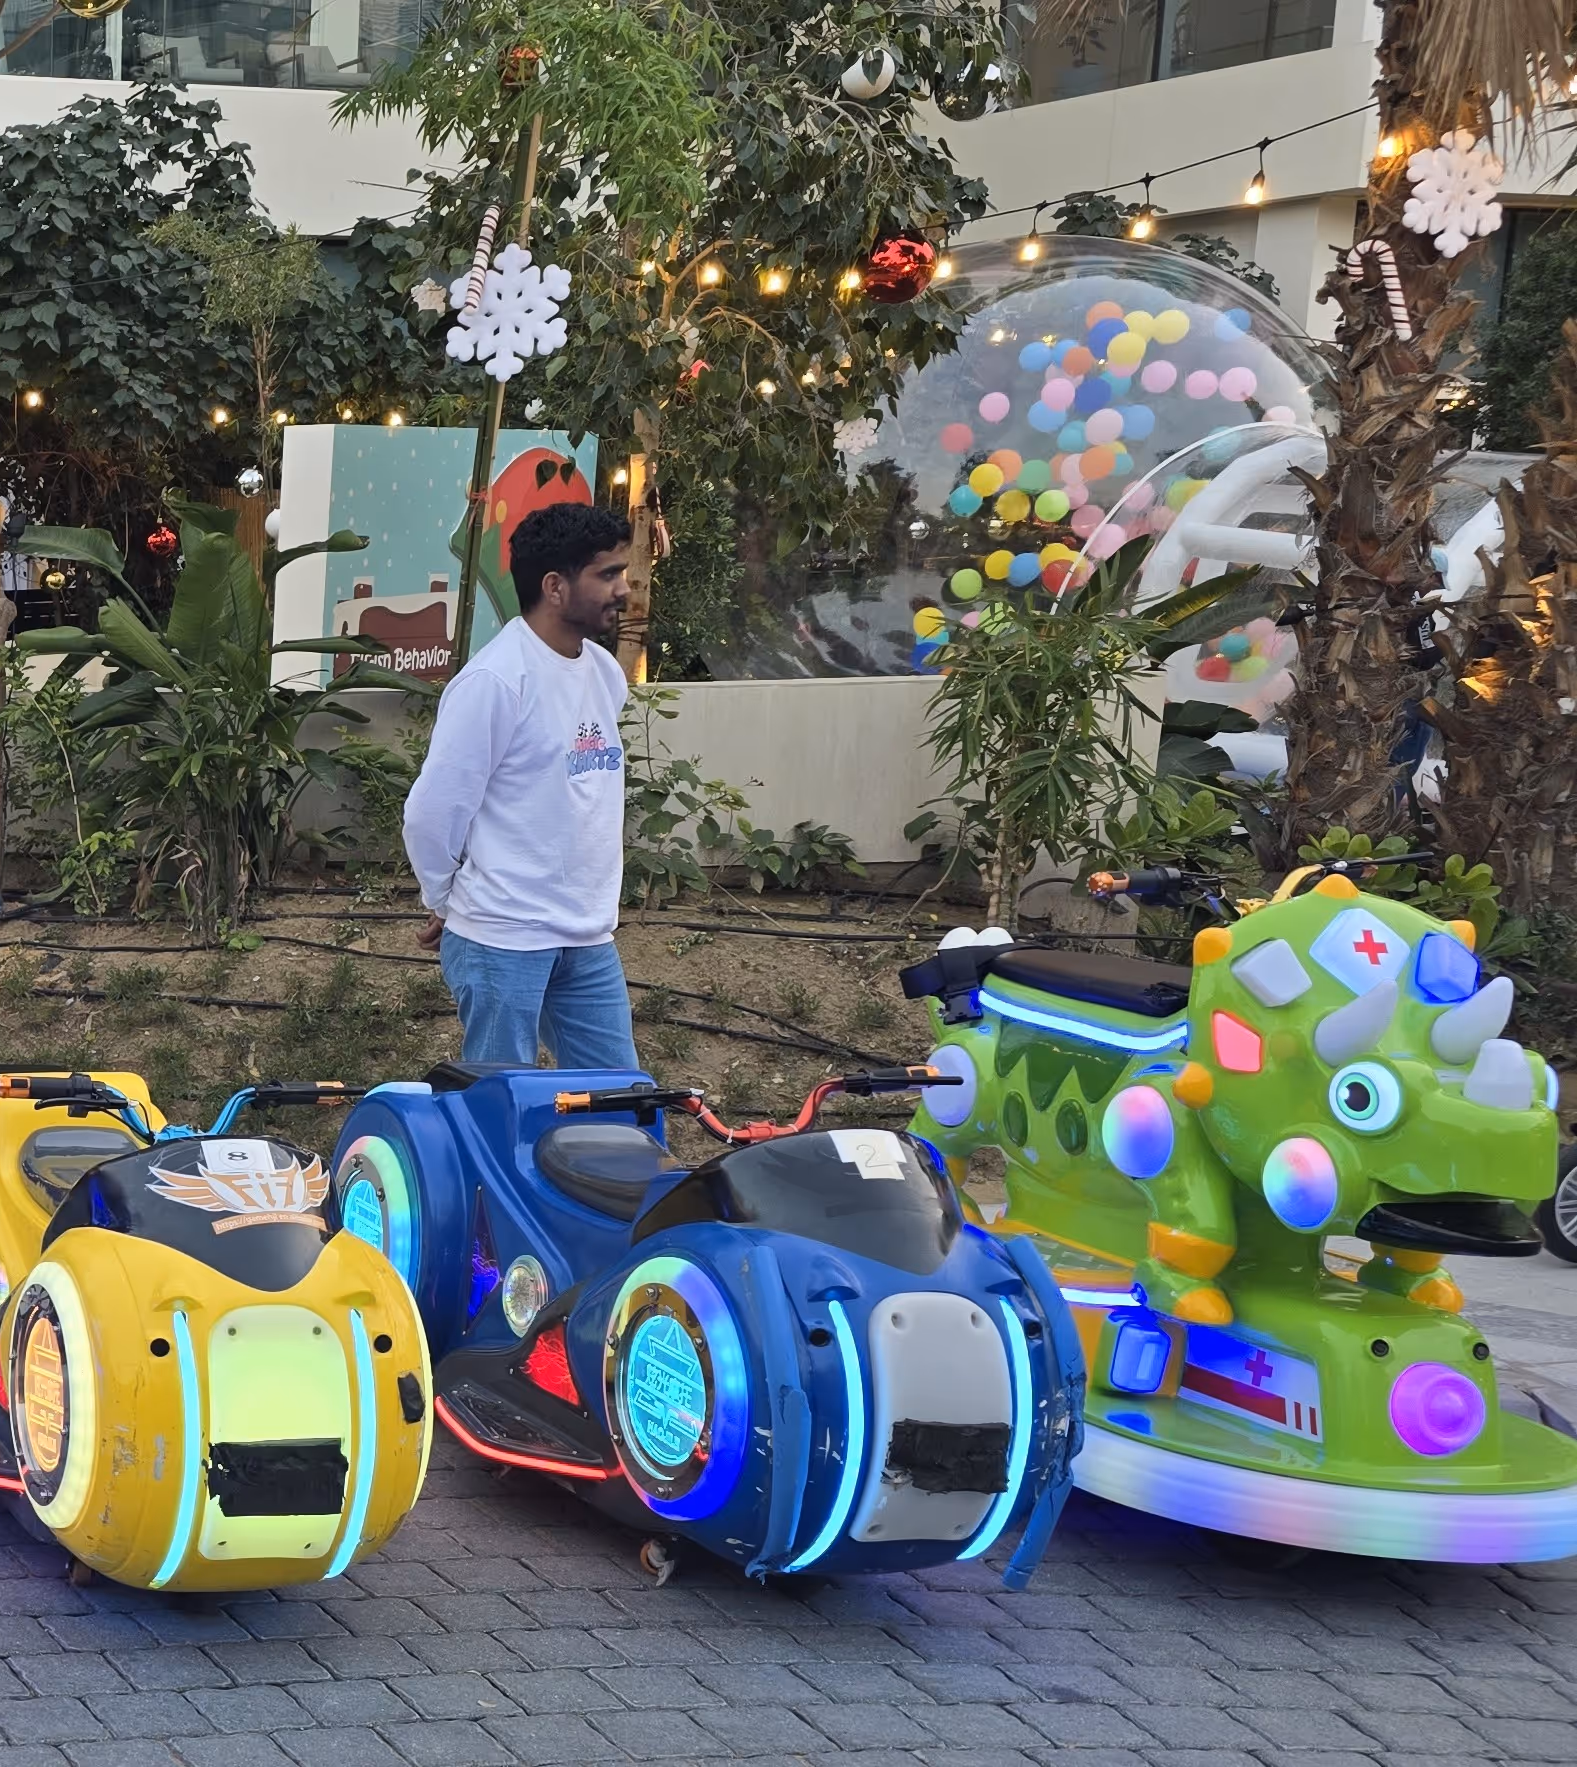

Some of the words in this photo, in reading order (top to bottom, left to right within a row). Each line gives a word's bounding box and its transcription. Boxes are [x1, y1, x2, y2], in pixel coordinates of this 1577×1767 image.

[393, 646, 452, 672] Behavior
[566, 747, 622, 777] KARTZ
[856, 1144, 893, 1168] 2
